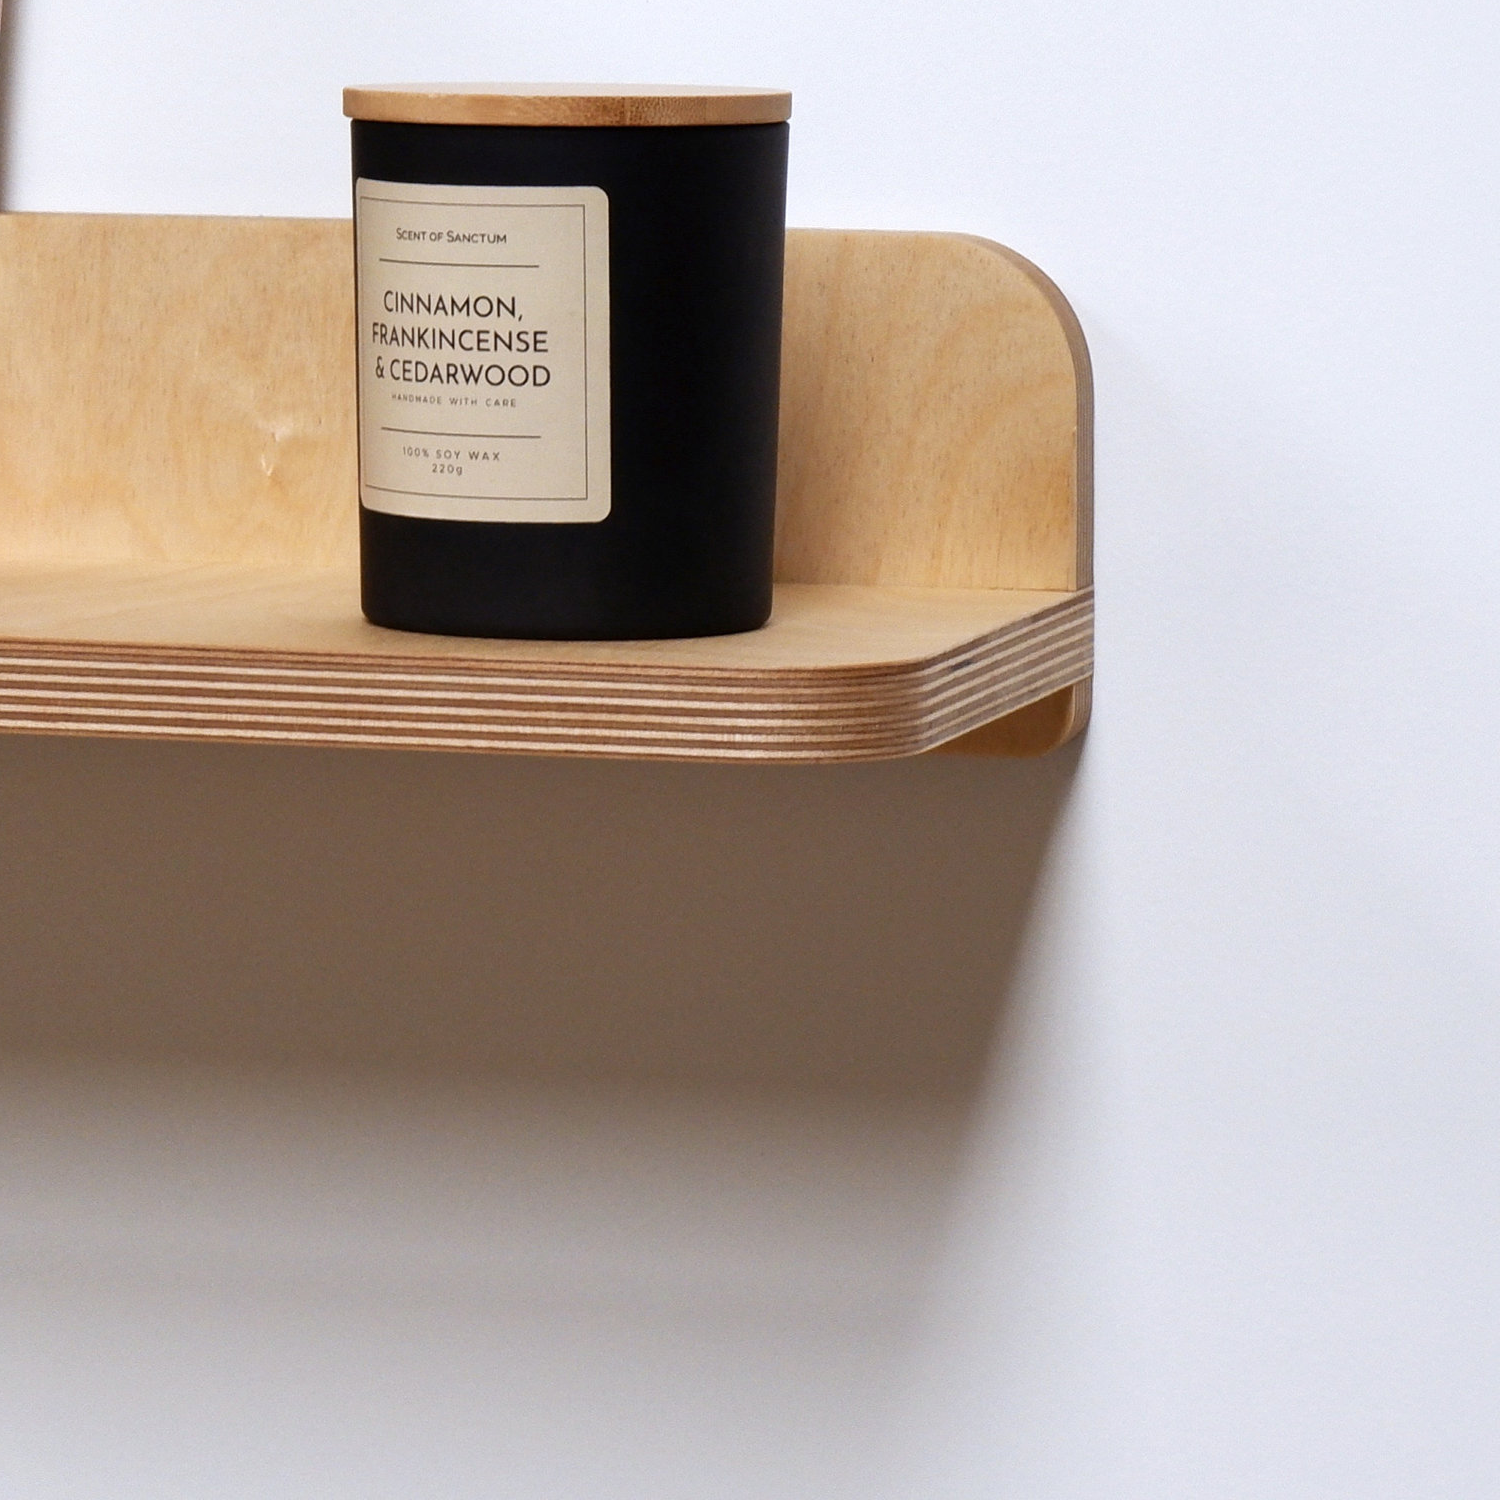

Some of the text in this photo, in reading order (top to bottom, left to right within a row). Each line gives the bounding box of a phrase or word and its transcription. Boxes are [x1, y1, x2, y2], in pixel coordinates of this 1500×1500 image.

[383, 289, 523, 322] CINNAMON,
[372, 321, 549, 353] FRANKINCENSE
[375, 356, 551, 388] & CEDARWOOD
[391, 393, 517, 408] HANDMADE WITH CARE
[402, 446, 500, 462] 100% SOY WAX
[431, 463, 463, 476] 220g
